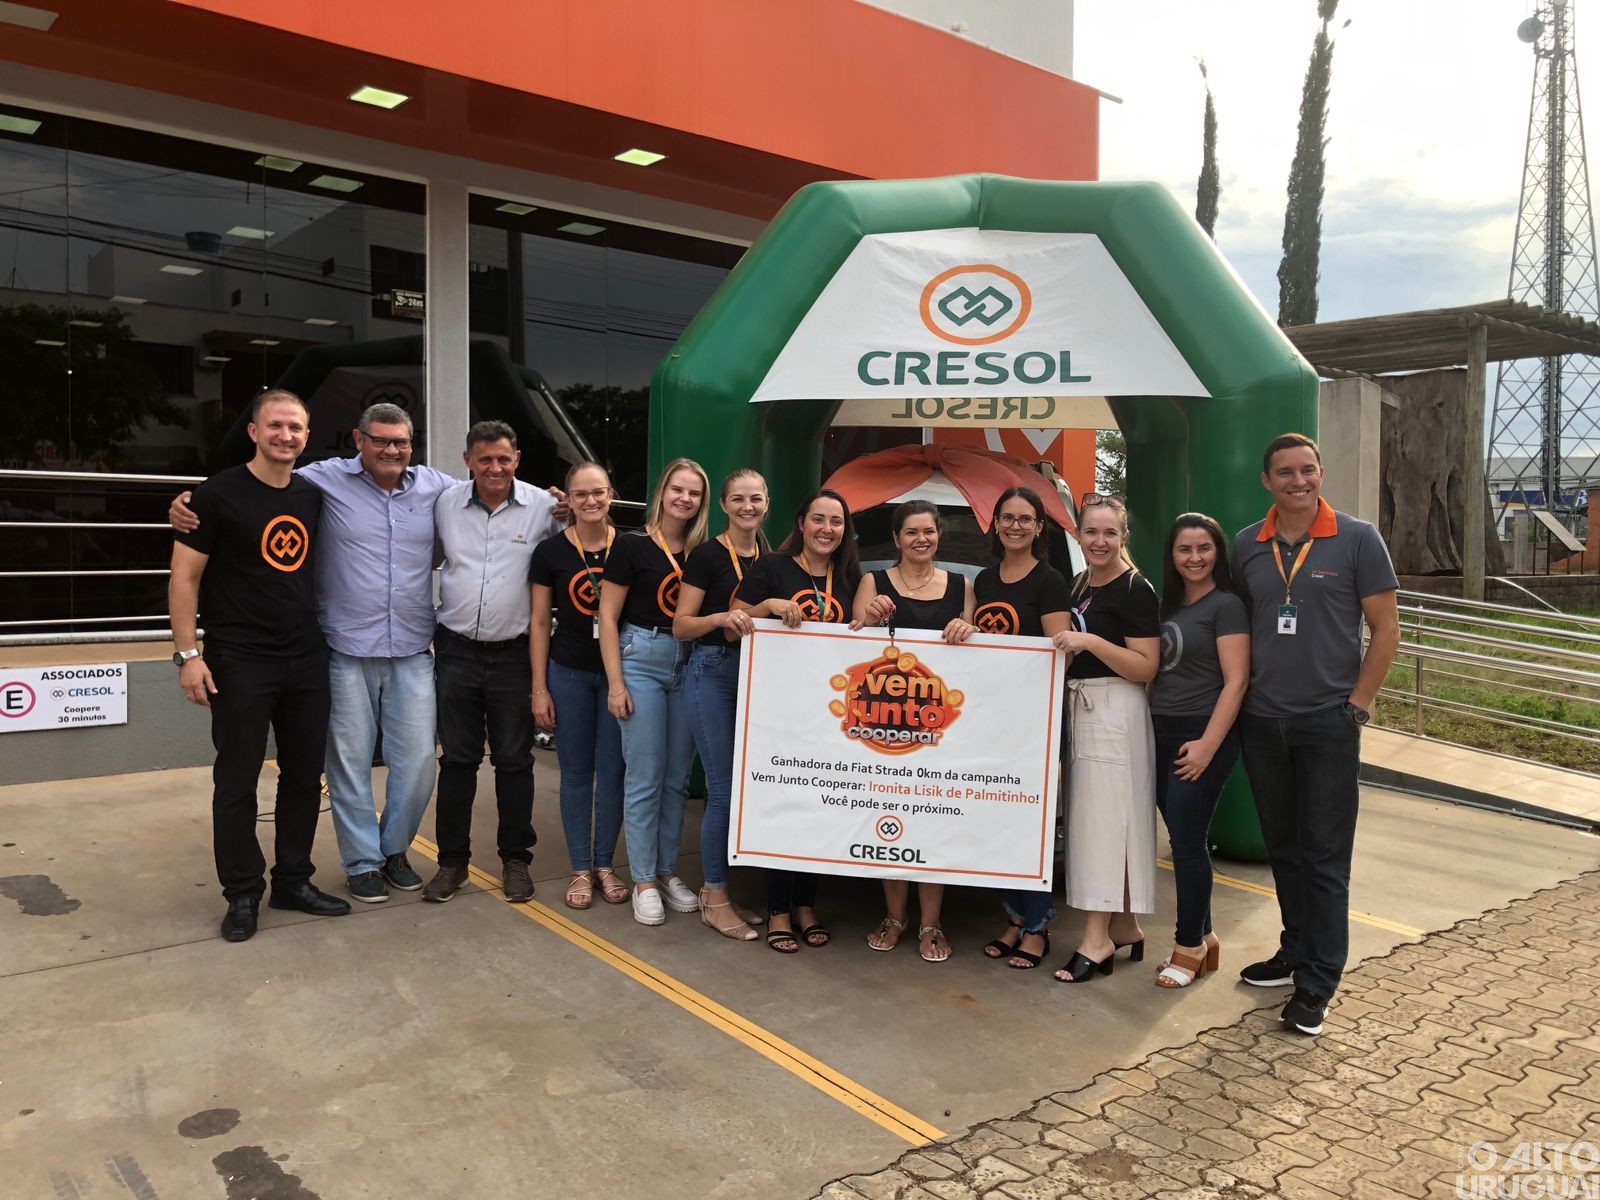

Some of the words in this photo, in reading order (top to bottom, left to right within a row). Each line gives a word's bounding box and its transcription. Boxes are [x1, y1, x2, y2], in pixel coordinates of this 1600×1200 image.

[857, 350, 1092, 386] CRESOL
[40, 668, 122, 681] ASSOCIADOS
[68, 687, 114, 697] CRESOL
[865, 673, 940, 699] vem
[6, 690, 23, 710] E
[64, 706, 101, 714] Coopere
[844, 691, 945, 728] junto
[72, 714, 107, 722] minutos
[848, 726, 940, 745] cooperar
[771, 756, 832, 771] Ganhadora
[834, 761, 848, 772] da
[851, 762, 873, 774] Fiat
[875, 765, 913, 777] Strada
[916, 767, 941, 779] 0km
[944, 770, 958, 780] da
[961, 773, 1021, 785] campanha
[751, 771, 775, 783] Vem
[778, 774, 809, 786] Junto
[811, 777, 866, 791] Cooperar:
[868, 781, 911, 795] Ironita
[914, 784, 943, 797] Lisik
[946, 787, 962, 798] de
[965, 788, 1039, 804] Palmitinho!
[821, 794, 848, 806] Você
[851, 798, 879, 810] pode
[882, 801, 899, 811] ser
[902, 803, 909, 812] o
[912, 802, 964, 816] próximo.
[849, 843, 926, 864] CRESOL
